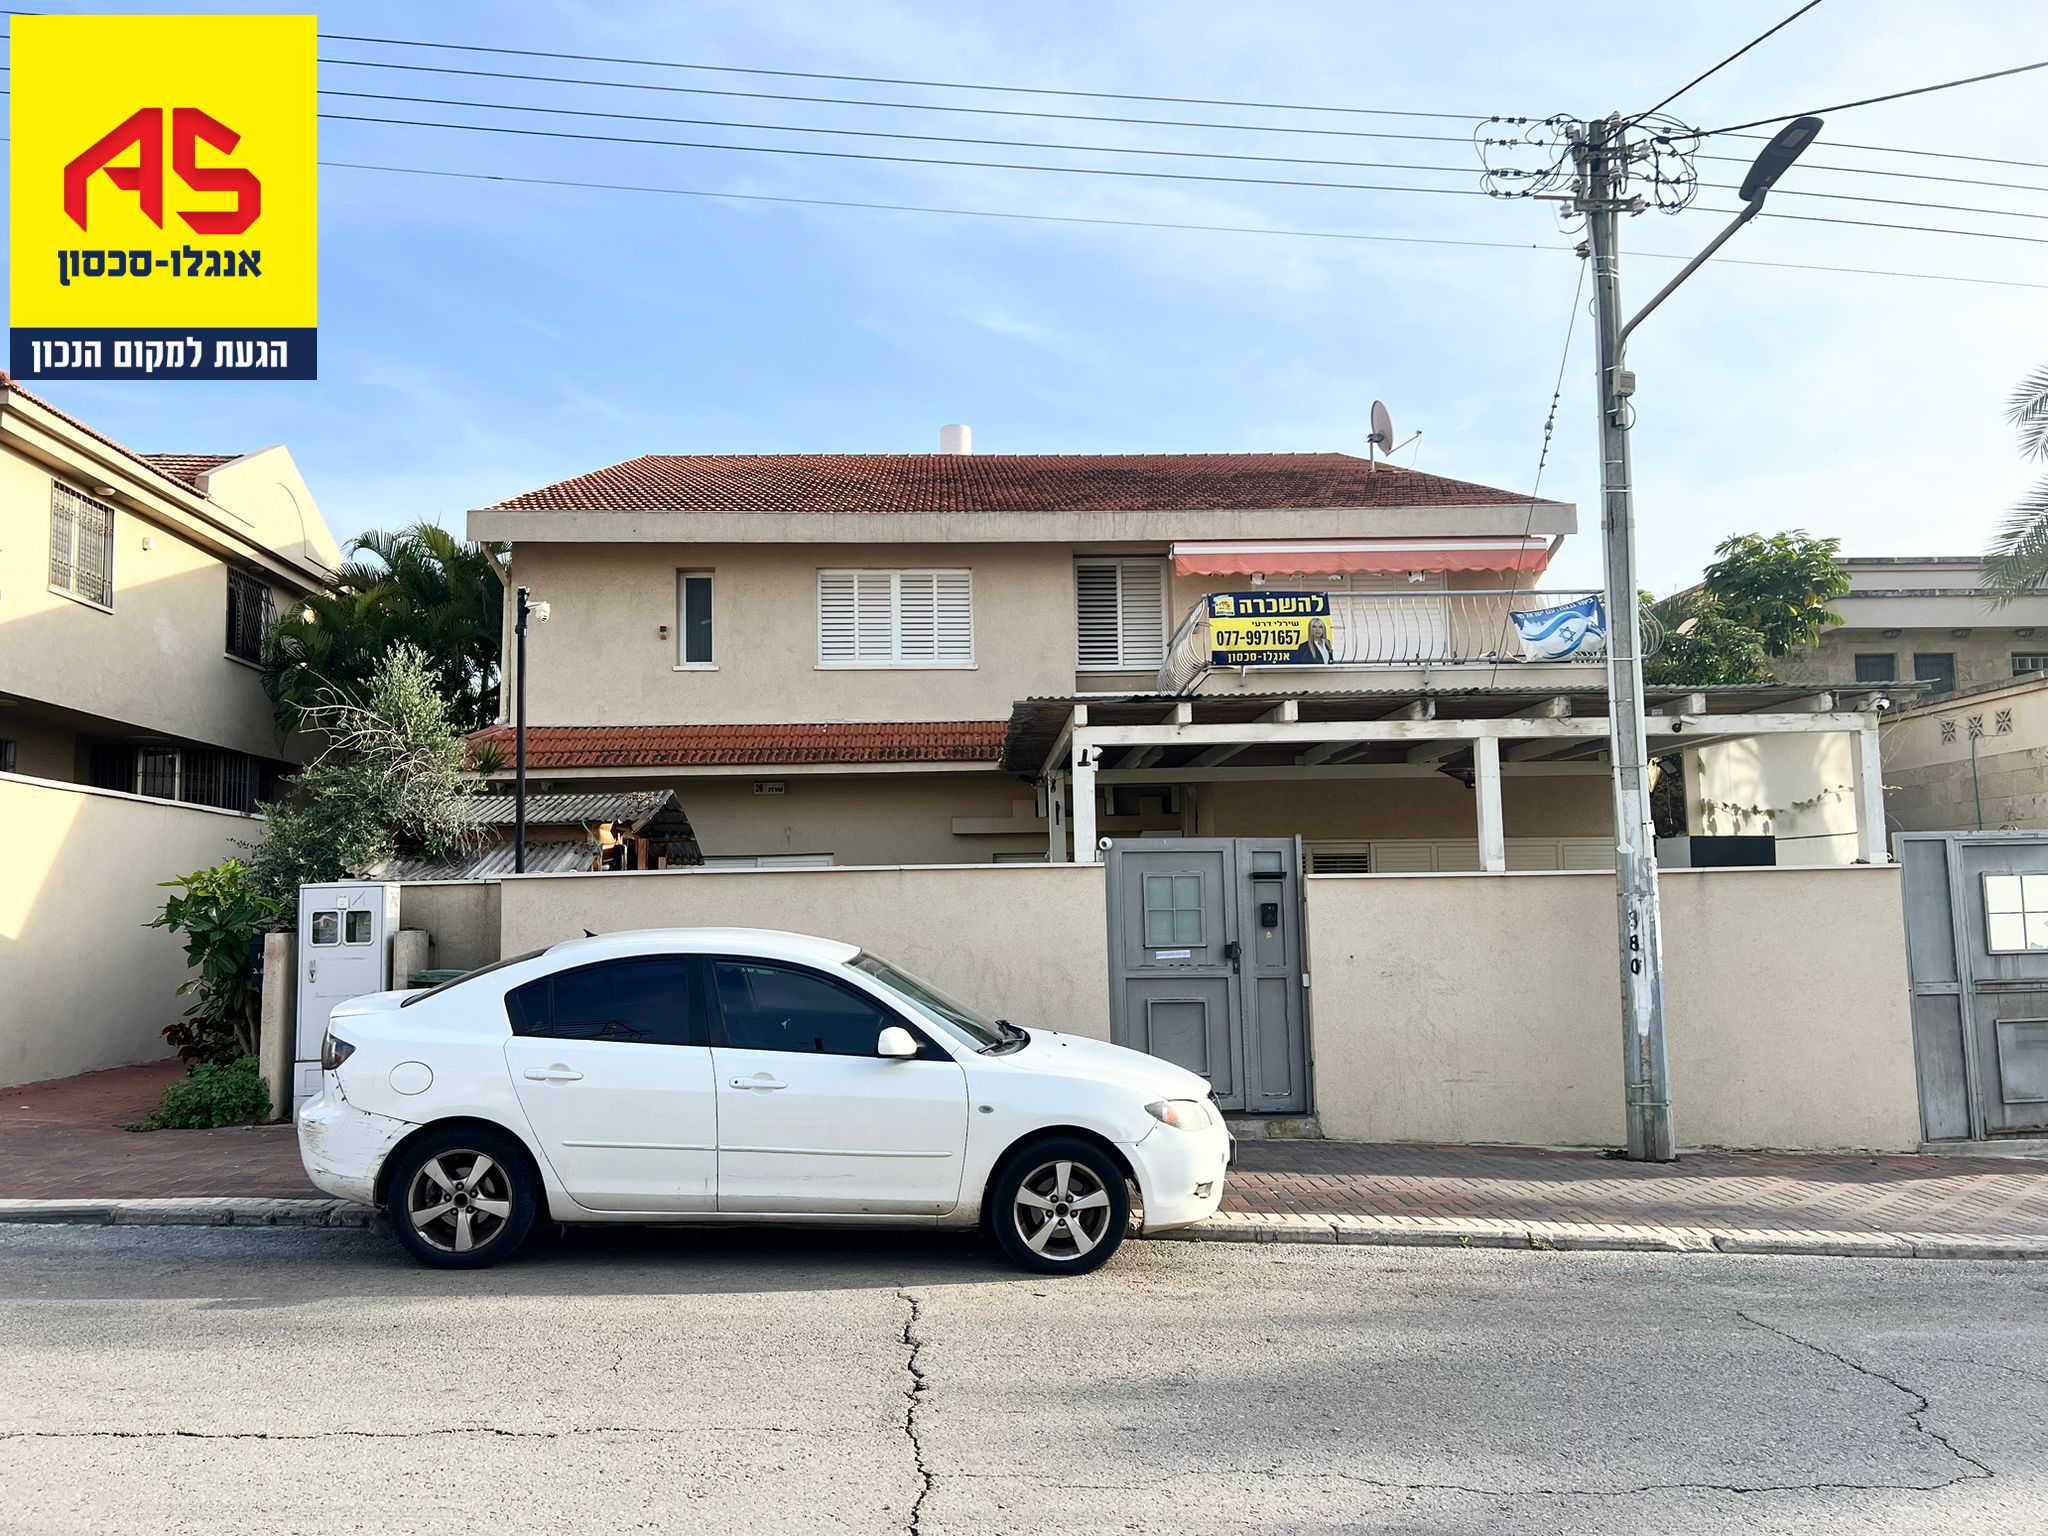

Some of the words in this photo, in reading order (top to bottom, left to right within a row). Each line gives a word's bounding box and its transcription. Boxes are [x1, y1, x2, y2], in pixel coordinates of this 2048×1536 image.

[1239, 595, 1324, 614] להשכרה
[1216, 629, 1301, 646] 077-9971657
[1228, 651, 1290, 663] אנגלו-סכסון
